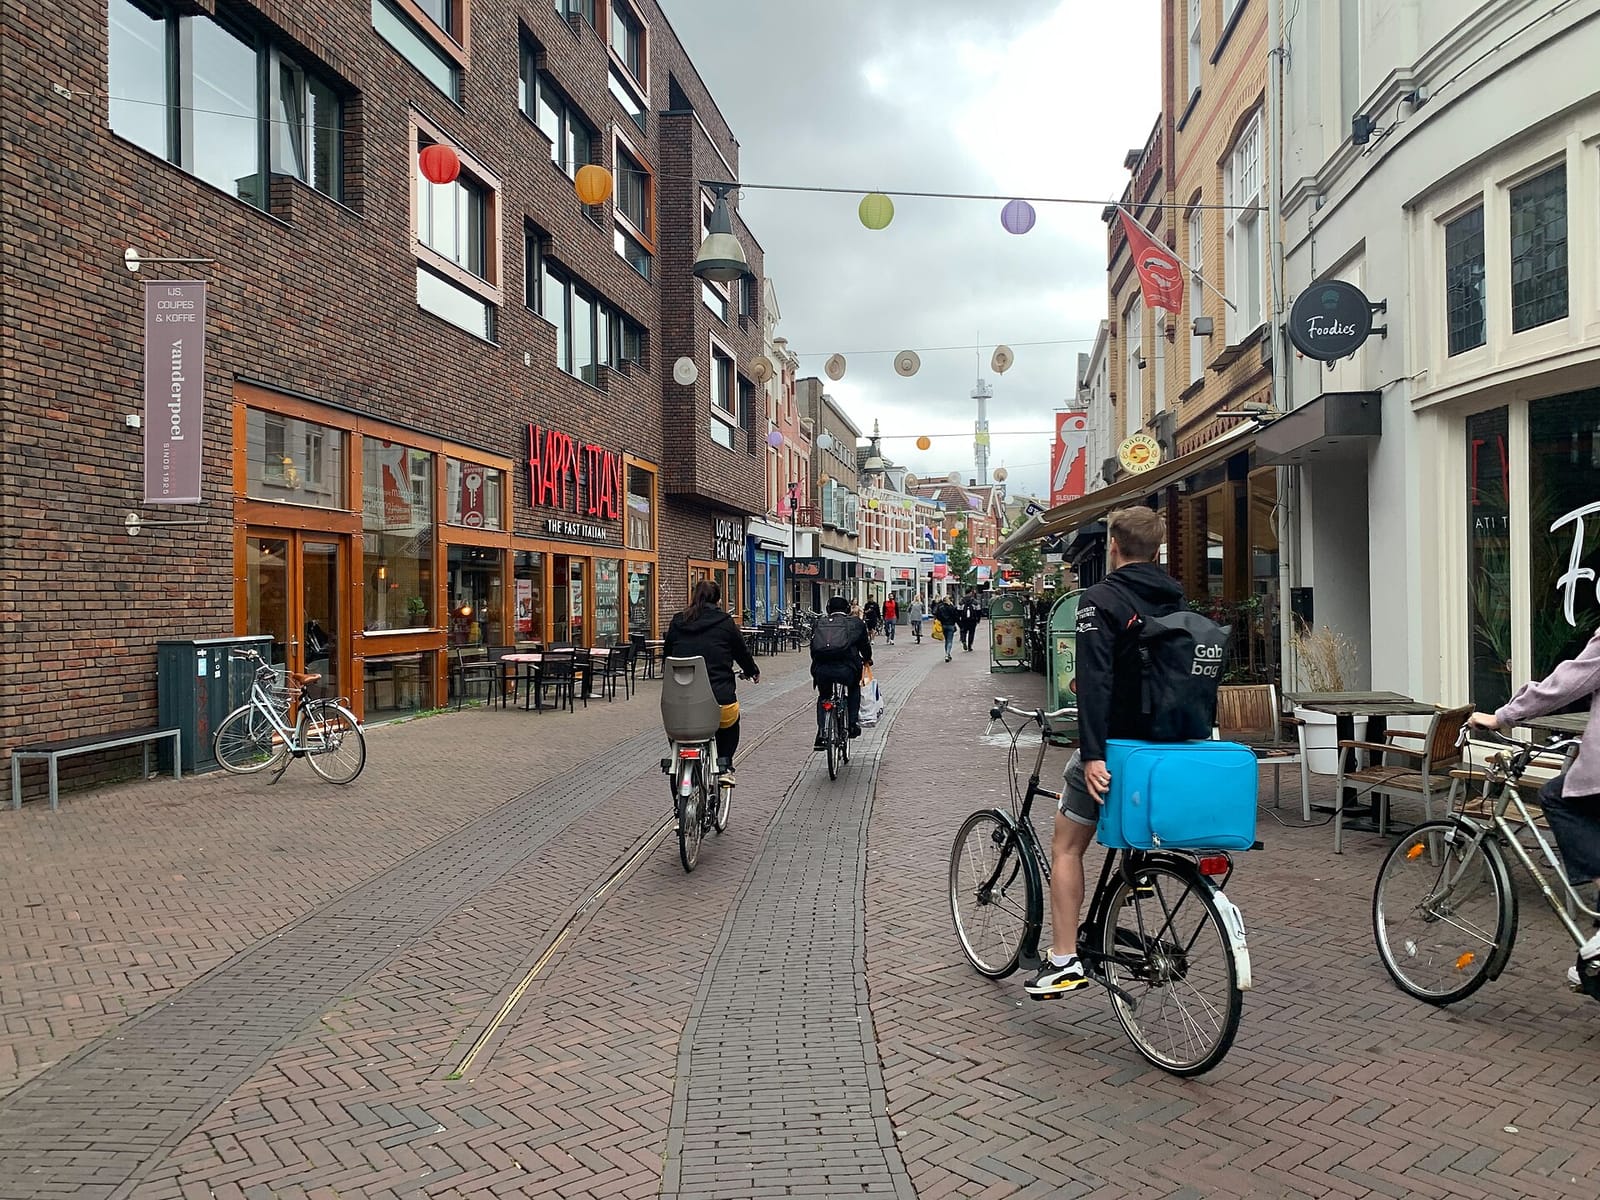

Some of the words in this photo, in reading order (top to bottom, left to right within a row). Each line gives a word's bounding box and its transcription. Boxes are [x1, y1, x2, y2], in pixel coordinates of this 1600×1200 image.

[157, 300, 195, 309] COUPES
[155, 314, 163, 322] &
[165, 314, 196, 322] KOFFIE
[1306, 315, 1356, 339] Foodies
[167, 338, 185, 441] vanderpoel
[527, 422, 582, 514] HAPPY
[585, 443, 622, 520] ITALY
[547, 519, 562, 533] THE
[564, 521, 581, 536] FAST
[582, 525, 607, 540] ITALIAN
[715, 518, 732, 540] LOVE
[716, 540, 728, 560] EAT
[1194, 644, 1223, 659] Gab
[1191, 661, 1220, 679] bag
